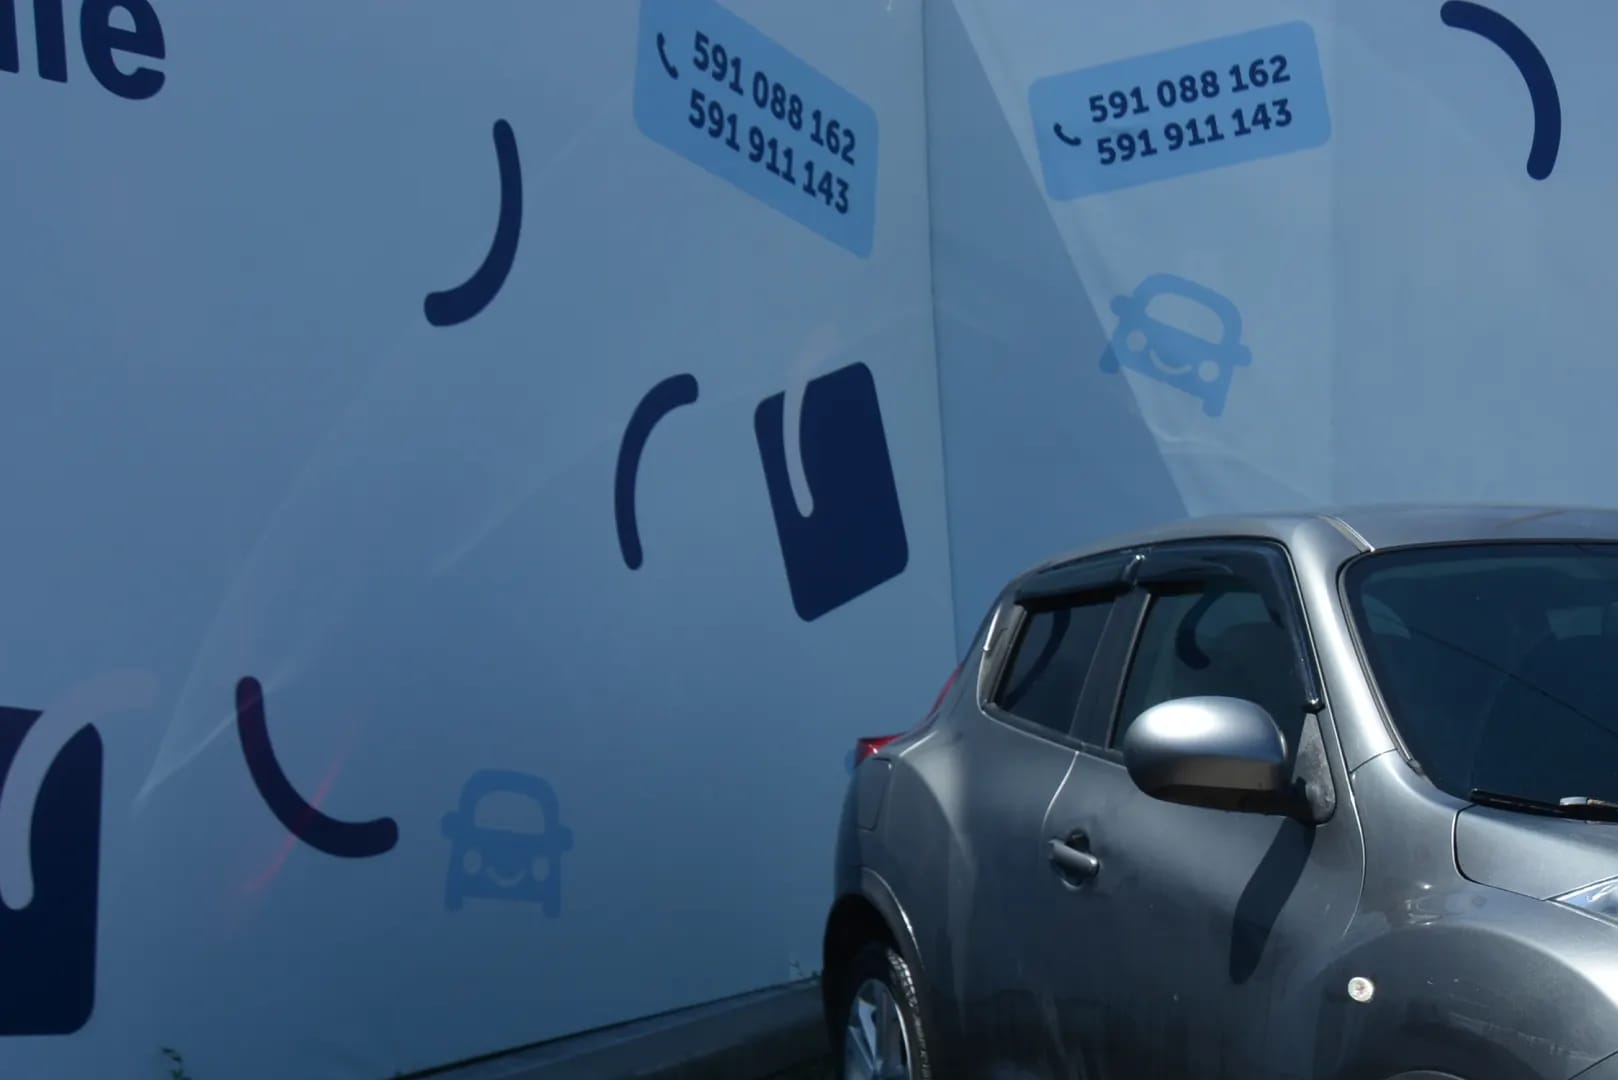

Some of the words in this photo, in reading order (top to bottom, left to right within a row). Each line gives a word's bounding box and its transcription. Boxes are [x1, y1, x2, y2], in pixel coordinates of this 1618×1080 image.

[0, 0, 166, 100] le
[693, 30, 744, 96] 591
[752, 71, 803, 131] 088
[810, 109, 856, 166] 162
[1089, 86, 1150, 123] 591
[1156, 70, 1220, 108] 088
[1229, 54, 1291, 93] 162
[688, 88, 741, 152] 591
[748, 126, 796, 185] 911
[802, 160, 849, 214] 143
[1096, 129, 1158, 165] 591
[1163, 114, 1225, 151] 911
[1231, 98, 1293, 137] 143
